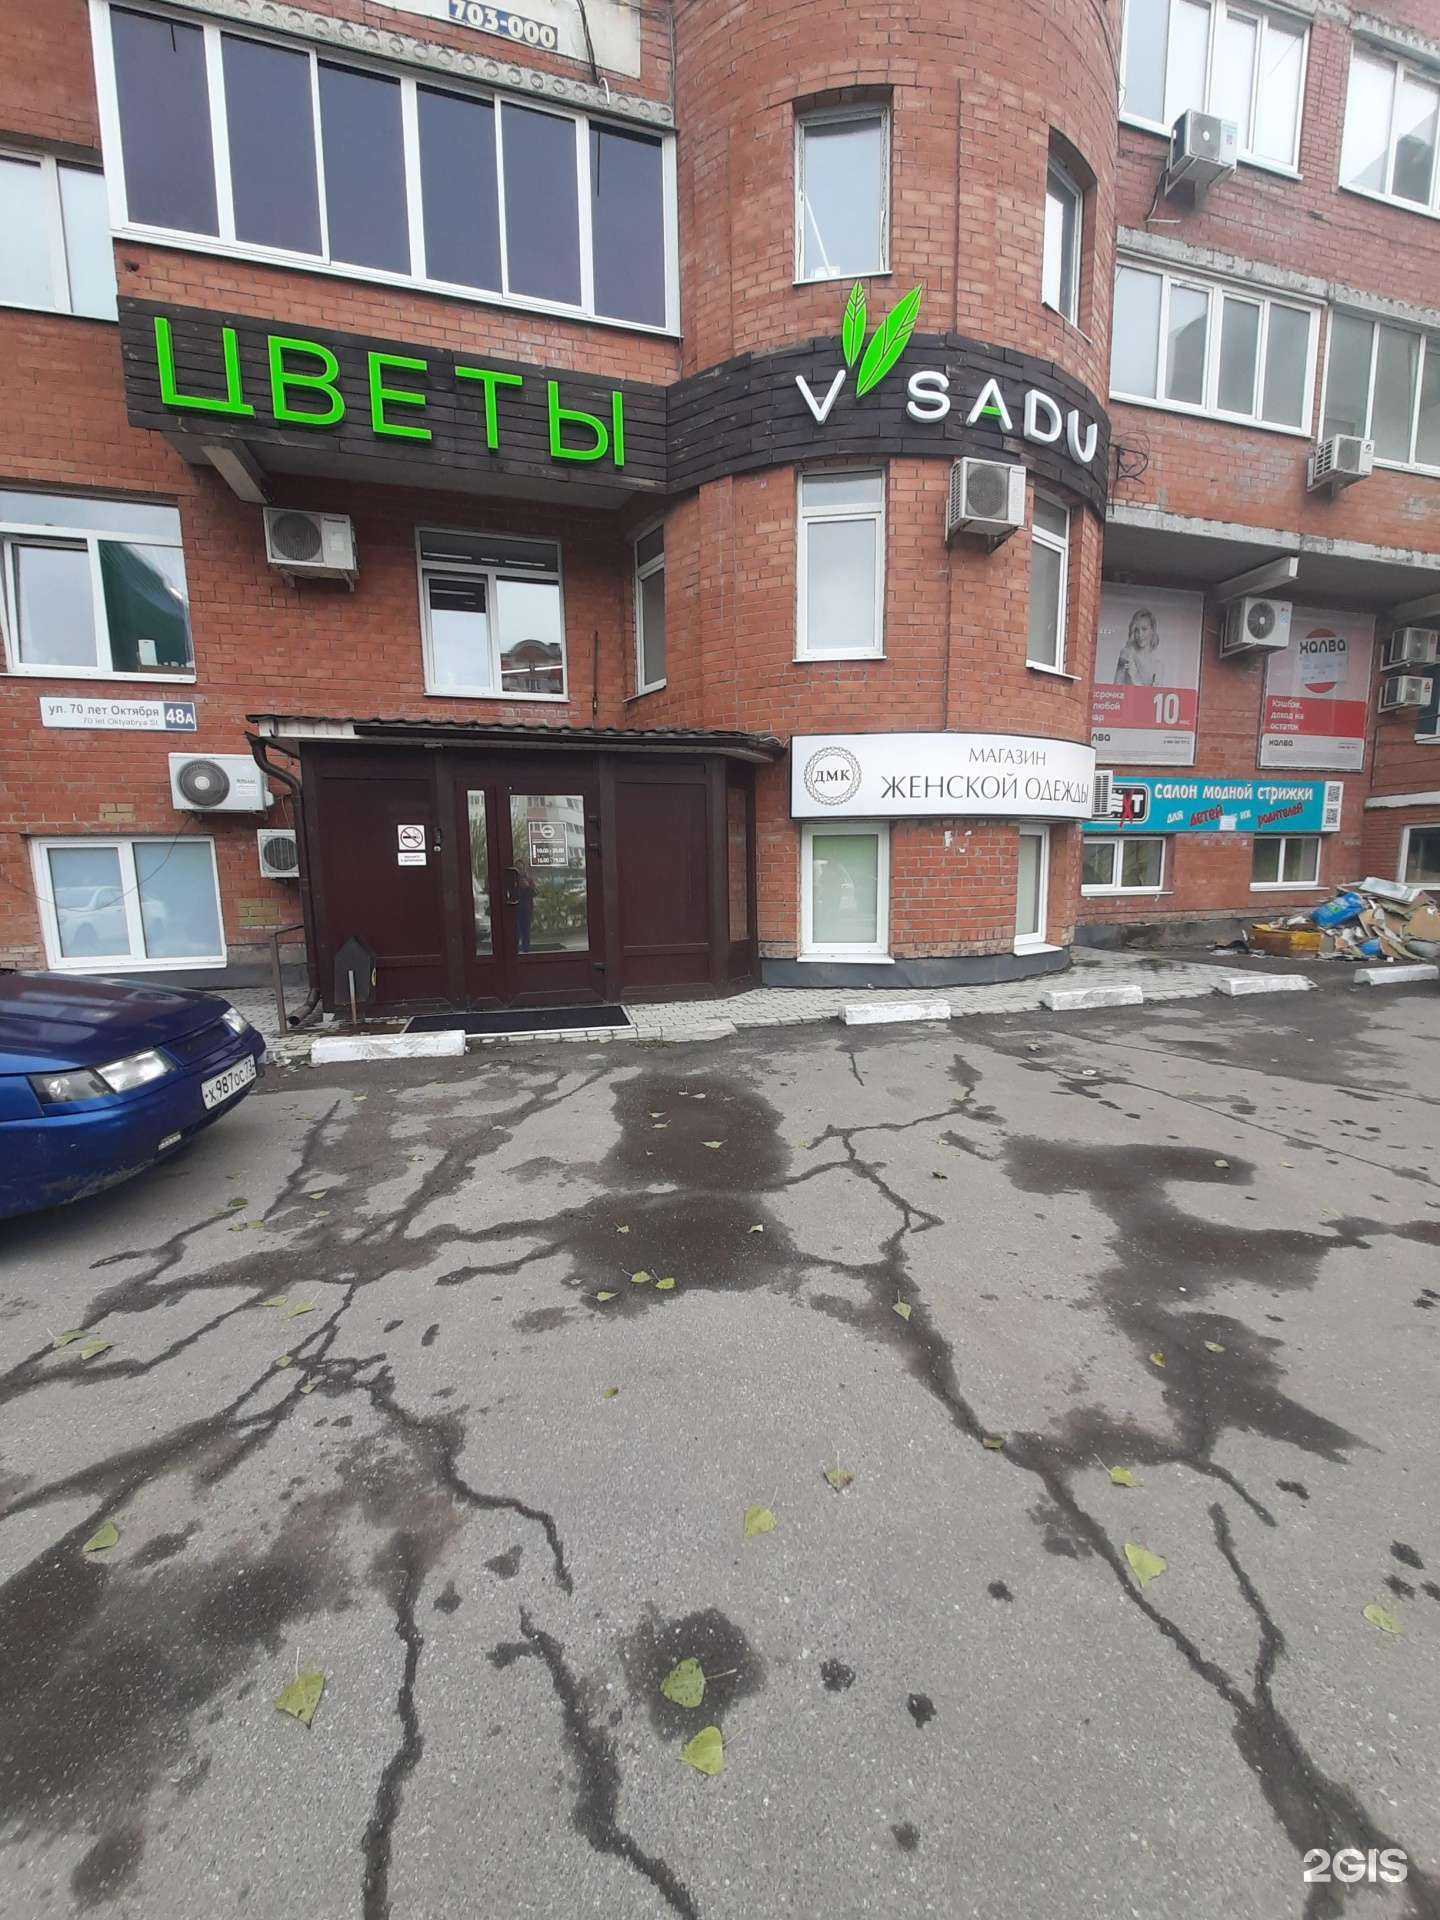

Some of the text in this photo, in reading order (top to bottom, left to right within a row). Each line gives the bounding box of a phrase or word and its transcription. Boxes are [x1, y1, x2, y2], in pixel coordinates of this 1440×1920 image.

[452, 0, 556, 48] 703-000
[154, 316, 626, 468] ЦВЕТЫ
[907, 370, 1098, 463] SADU
[48, 704, 159, 718] ул. 70 лет Октября
[1153, 692, 1180, 725] 10
[969, 747, 1046, 766] МАГАЗИН
[814, 769, 851, 784] ДМК
[880, 773, 1089, 805] ЖЕНСКОЙ ОДЕЖДЫ
[1202, 783, 1253, 800] модной
[1257, 786, 1313, 805] стрижки
[1166, 809, 1184, 824] для
